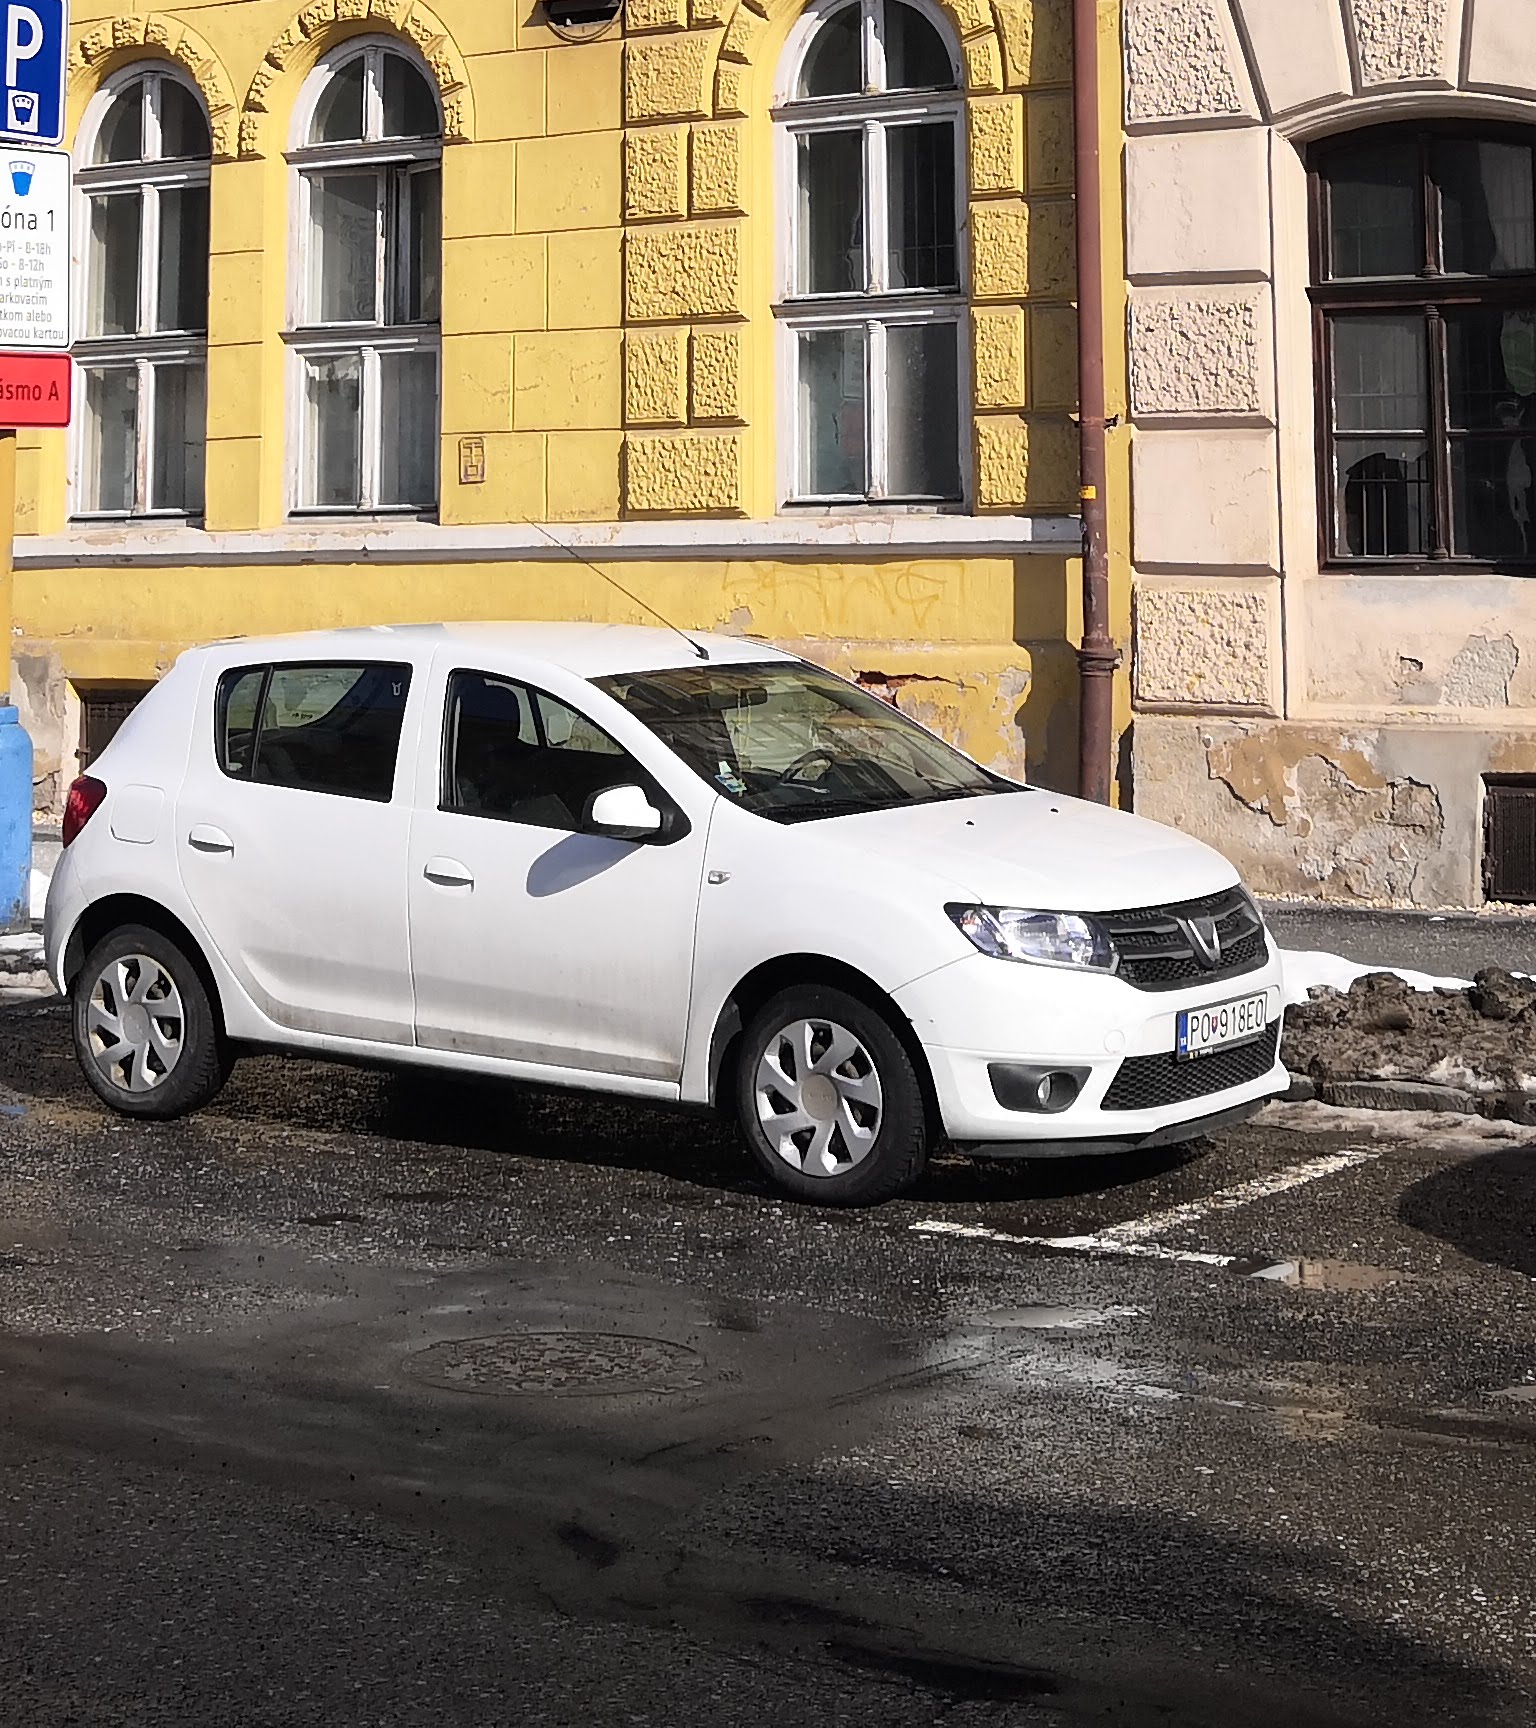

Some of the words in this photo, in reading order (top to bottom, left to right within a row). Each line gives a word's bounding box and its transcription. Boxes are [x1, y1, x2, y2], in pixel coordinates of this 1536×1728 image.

[6, 4, 43, 87] P
[47, 210, 54, 232] 1
[6, 276, 11, 286] s
[26, 310, 52, 323] alebo
[33, 326, 64, 340] kartou
[47, 380, 59, 401] A
